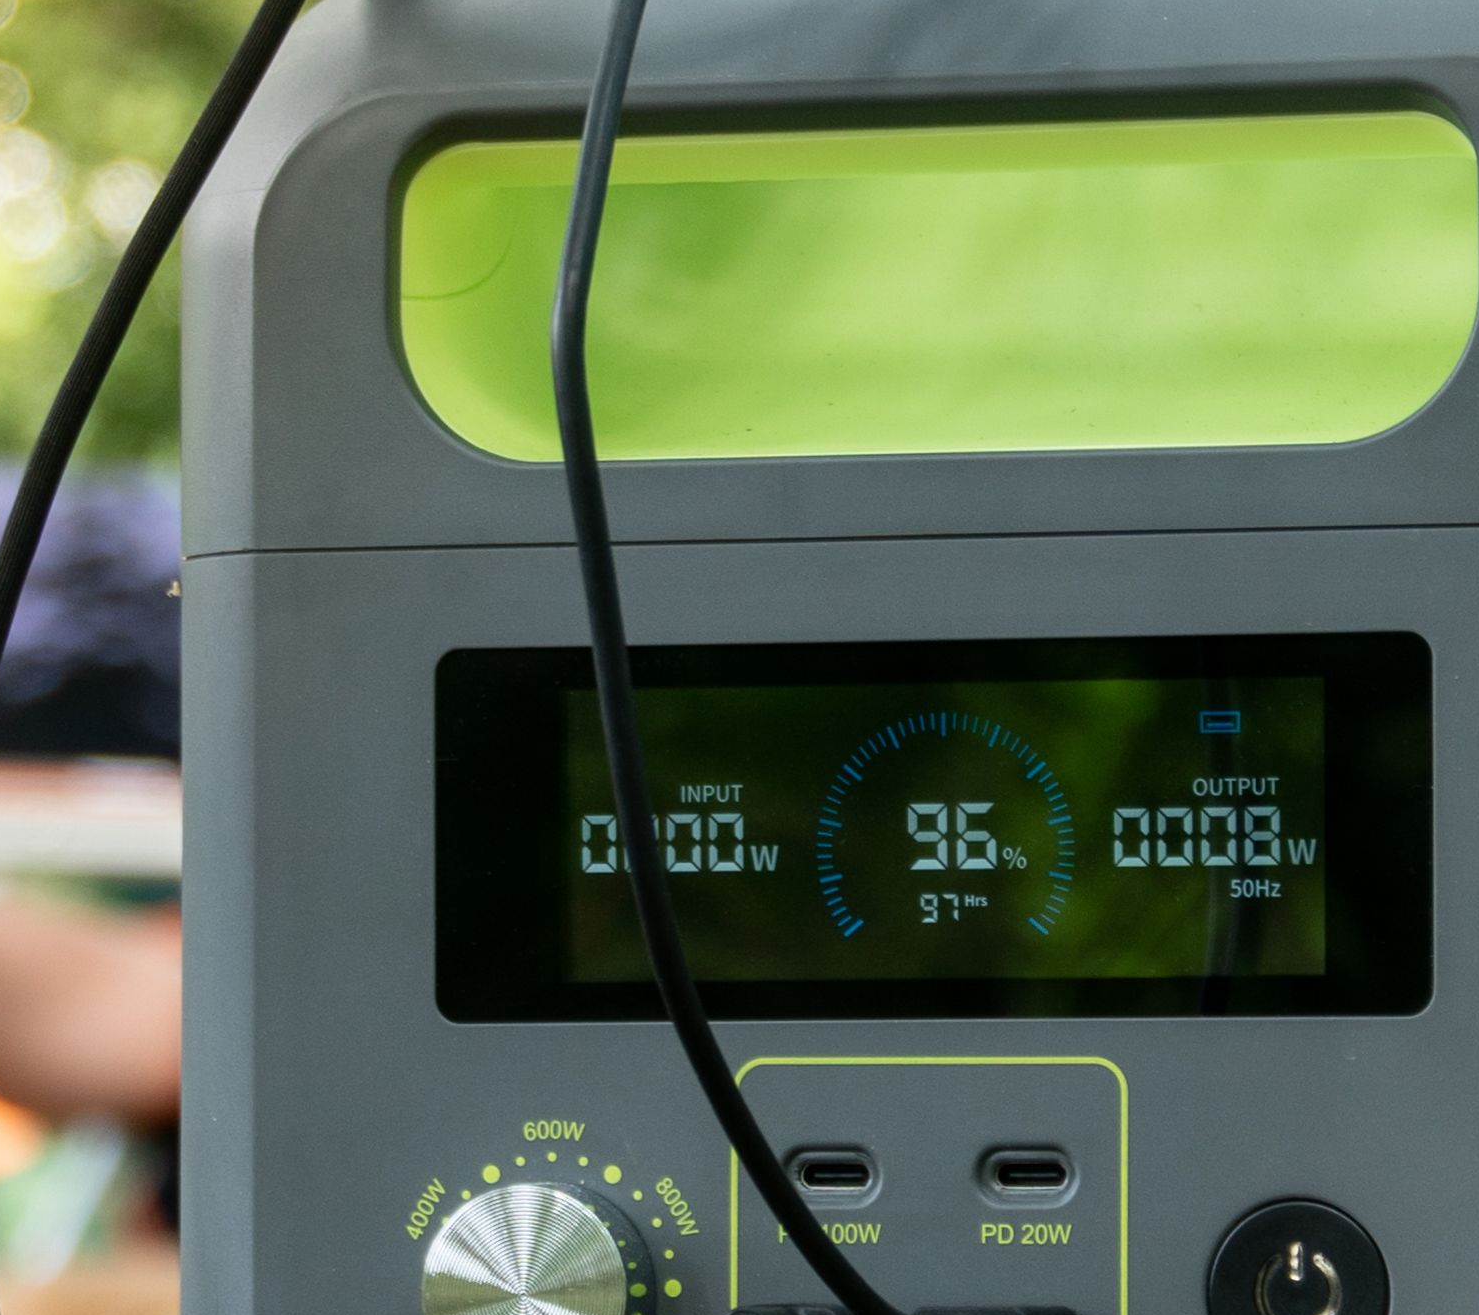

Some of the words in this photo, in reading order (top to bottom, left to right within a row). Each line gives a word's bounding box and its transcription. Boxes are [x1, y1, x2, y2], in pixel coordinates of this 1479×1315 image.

[681, 784, 743, 803] INPUT
[1192, 777, 1280, 796] OUTPUT
[581, 813, 778, 874] 000W
[1230, 879, 1281, 898] 50Hz
[522, 1119, 586, 1142] 600W
[406, 1177, 447, 1240] 400W
[655, 1177, 700, 1237] 800W
[980, 1223, 1015, 1245] PD
[1020, 1223, 1073, 1245] 20W
